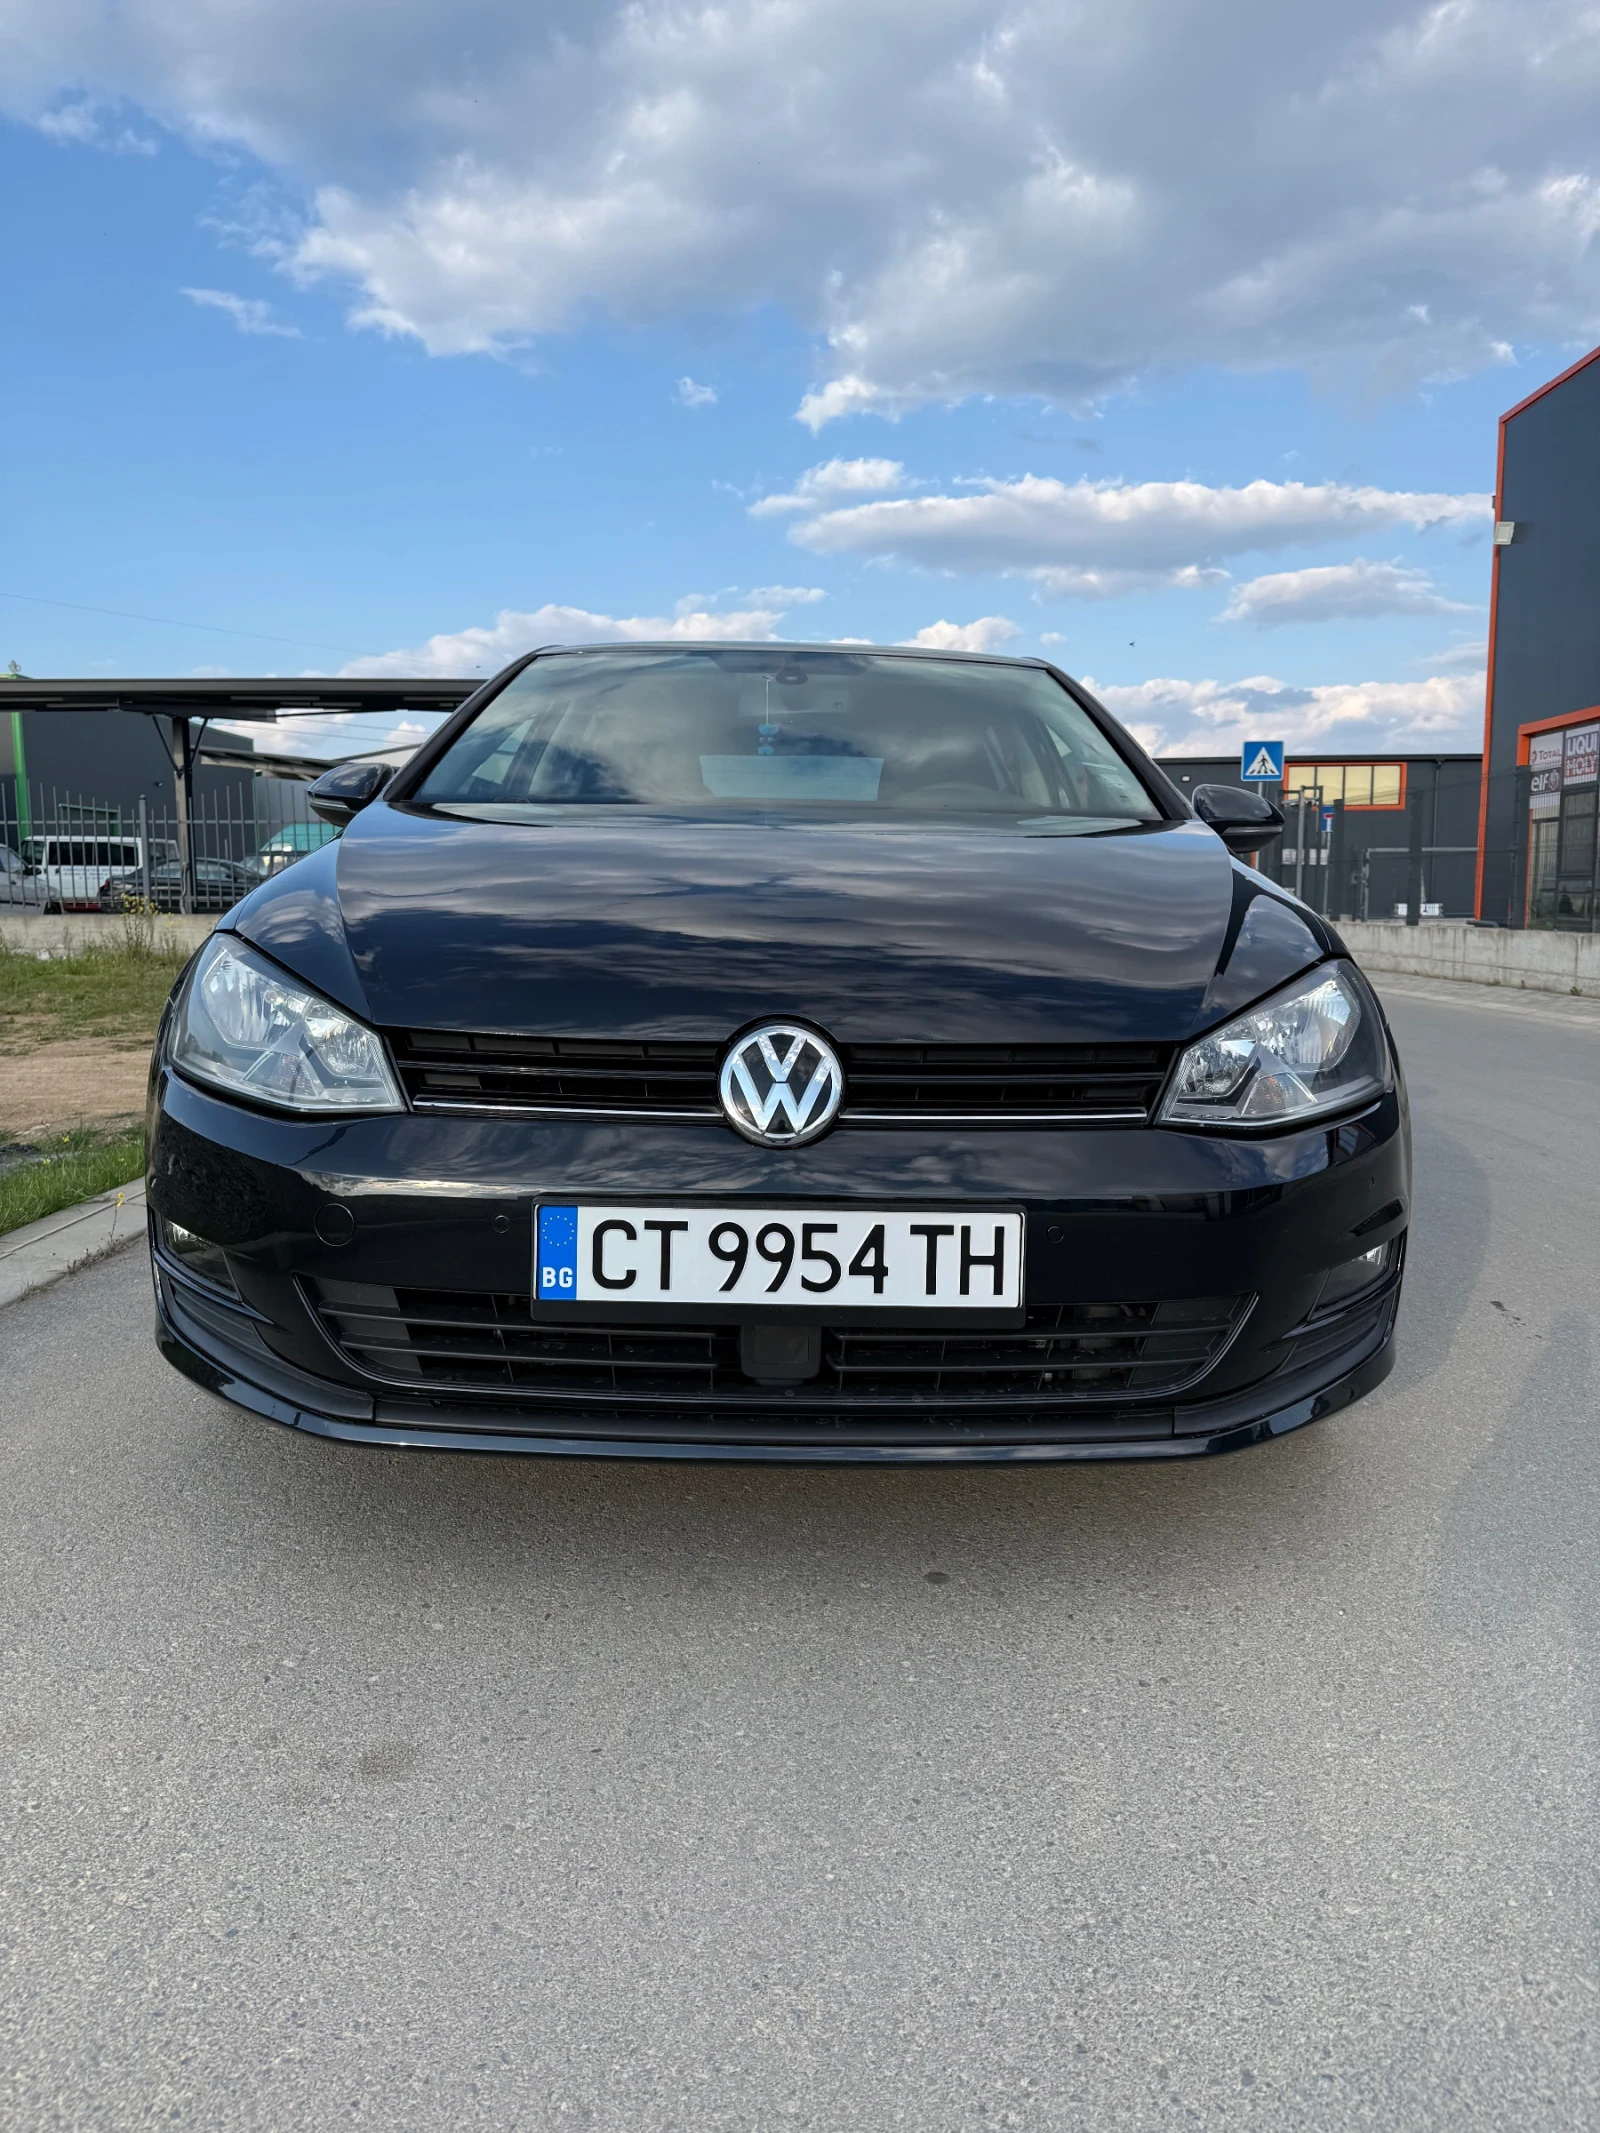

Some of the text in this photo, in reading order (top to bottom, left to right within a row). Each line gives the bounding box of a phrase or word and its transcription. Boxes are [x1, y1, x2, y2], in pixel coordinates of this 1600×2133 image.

[1539, 748, 1563, 760] TOTAL
[1567, 732, 1598, 756] LIQUI
[1566, 755, 1598, 776] MOLY
[1530, 773, 1549, 792] elf
[591, 1218, 1006, 1296] CT 9954 TH
[541, 1266, 574, 1289] BG
